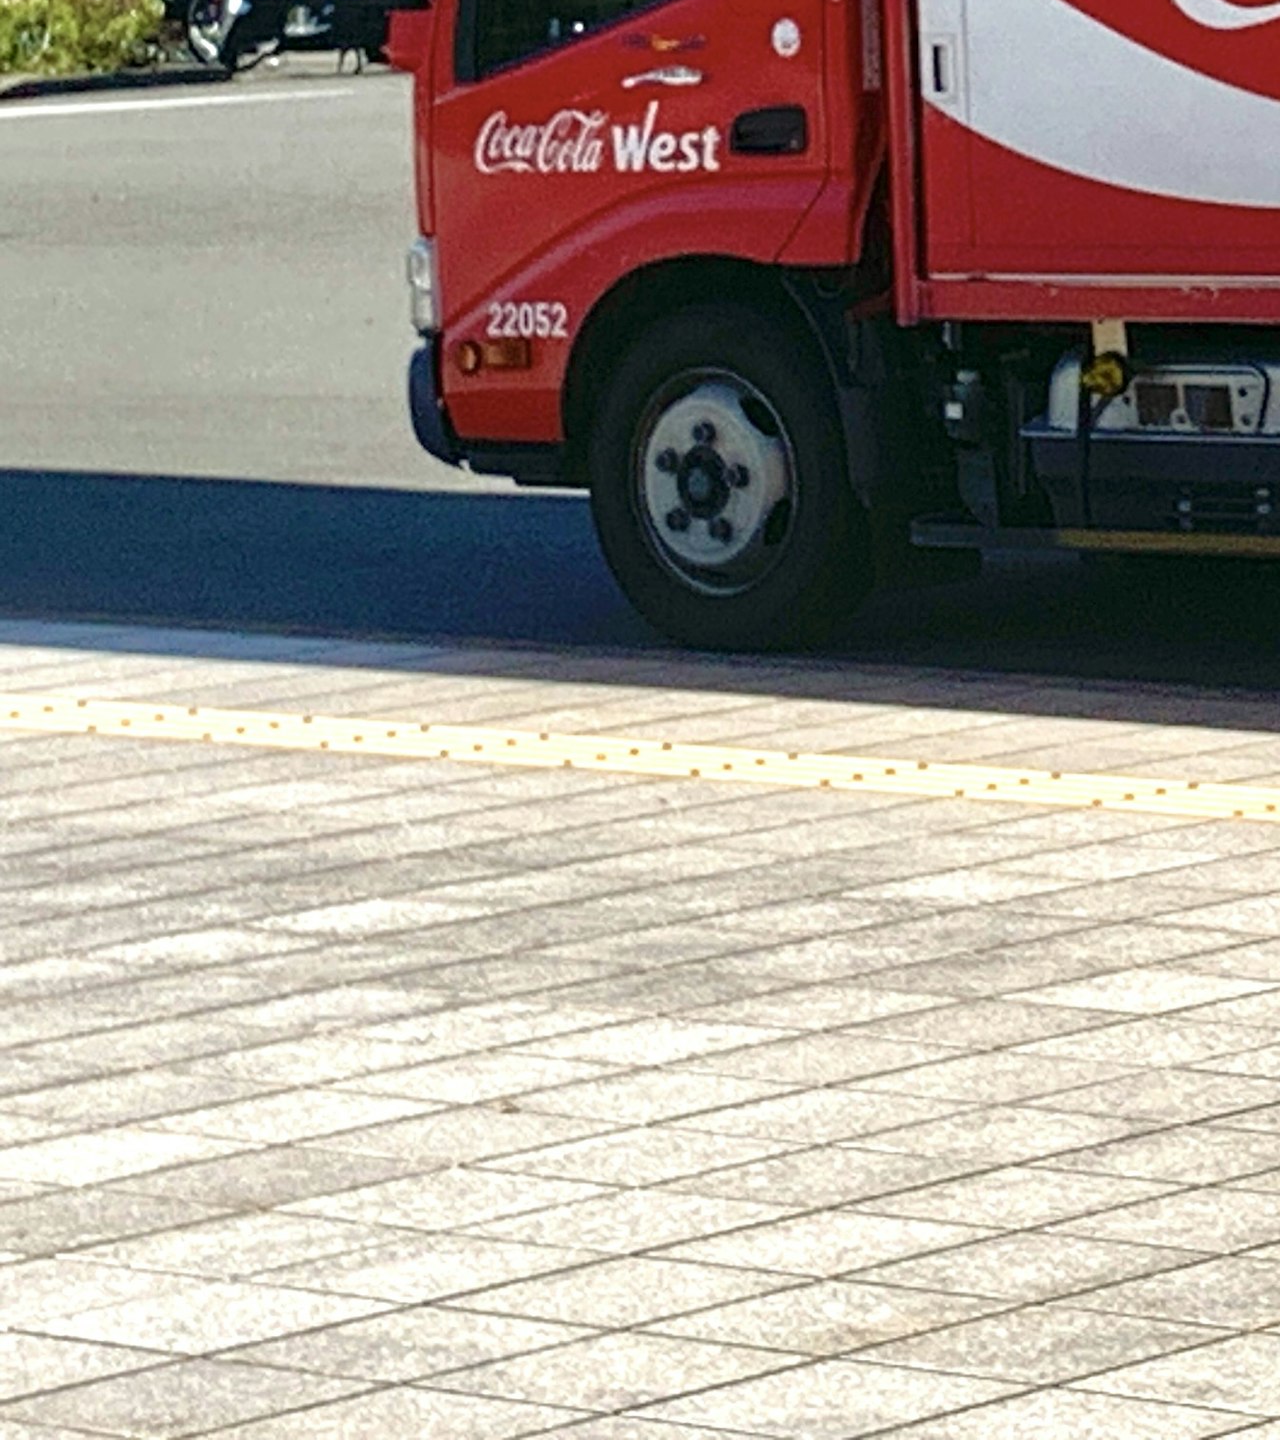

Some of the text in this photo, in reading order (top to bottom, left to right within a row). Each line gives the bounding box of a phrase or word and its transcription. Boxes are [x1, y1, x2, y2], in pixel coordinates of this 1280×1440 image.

[474, 100, 720, 173] Coca-Cola West
[486, 301, 569, 338] 22052
